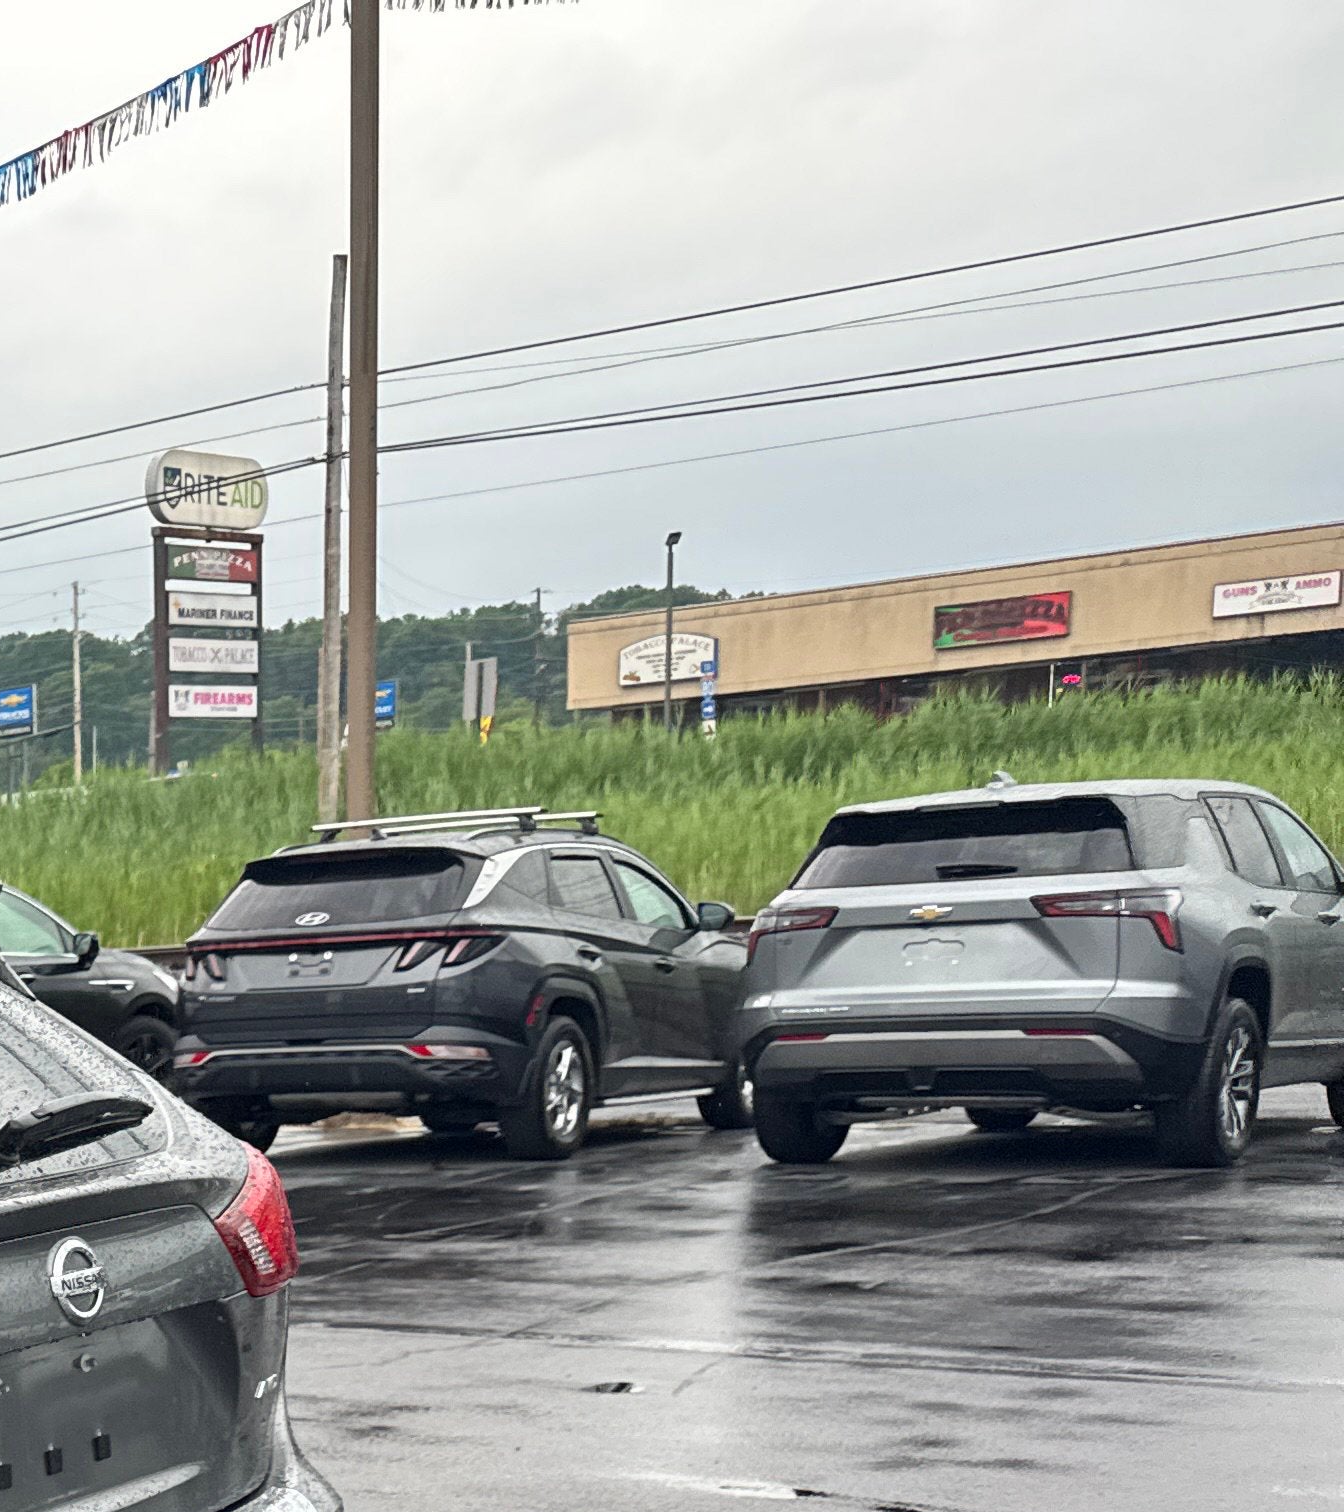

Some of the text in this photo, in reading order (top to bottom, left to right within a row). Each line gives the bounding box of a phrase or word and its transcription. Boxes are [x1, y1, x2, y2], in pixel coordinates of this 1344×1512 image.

[184, 472, 264, 509] RITE AID
[1222, 585, 1258, 599] GUNS
[1295, 577, 1332, 590] AMMO
[178, 607, 254, 621] MARINER FINANCE
[193, 691, 254, 706] FIREARMS
